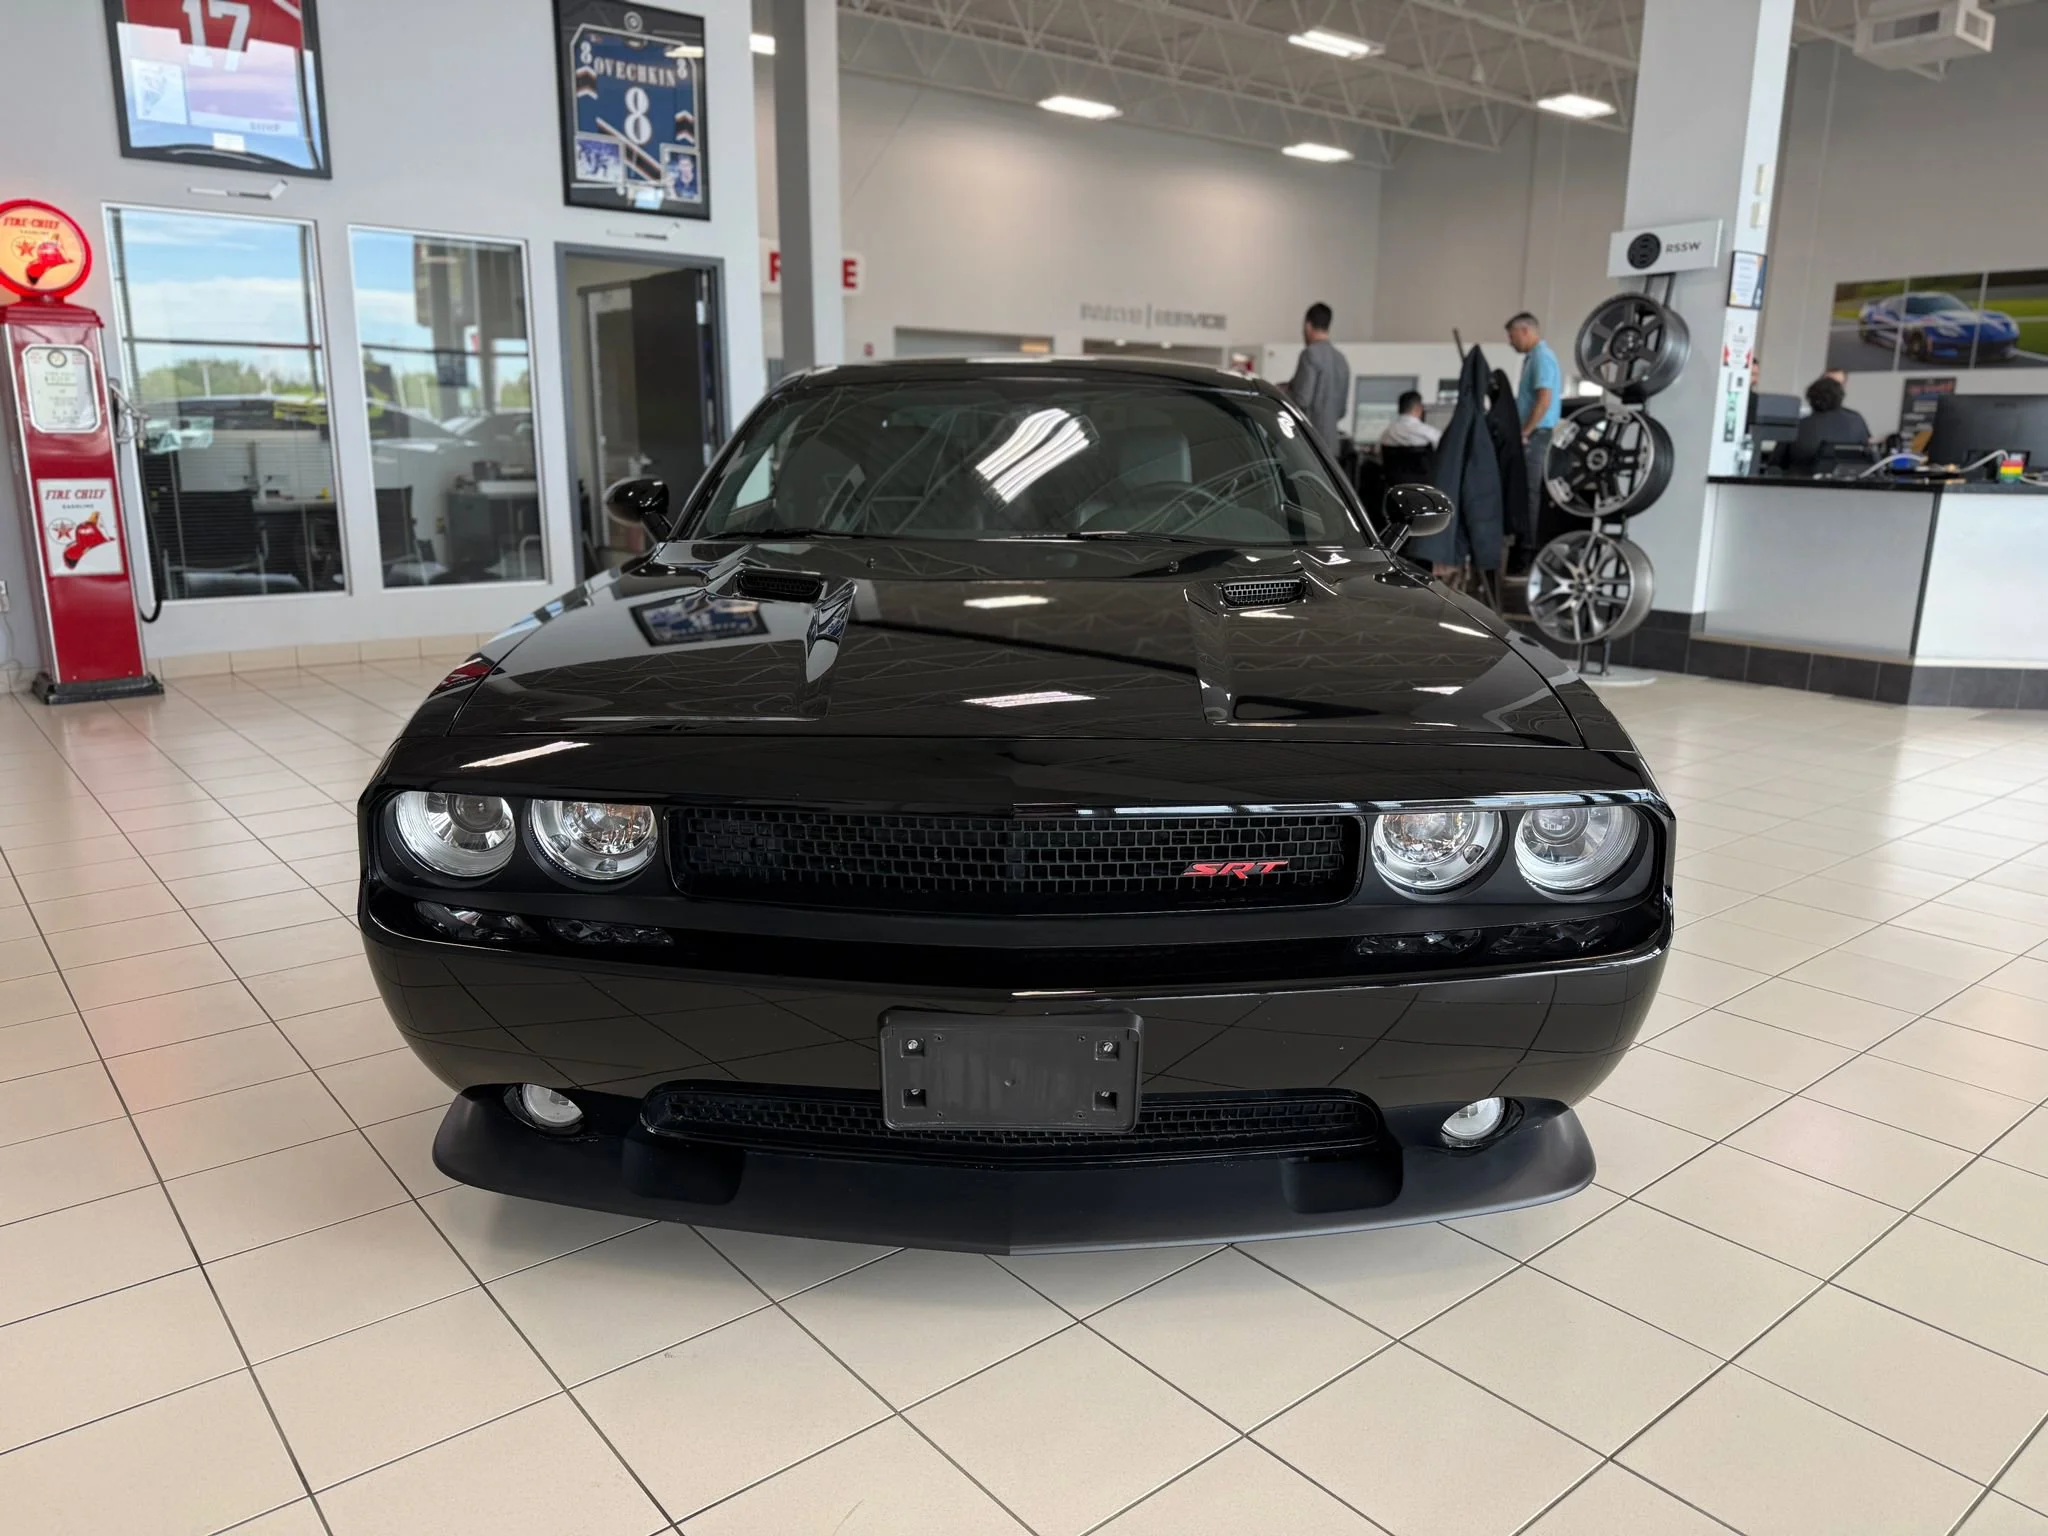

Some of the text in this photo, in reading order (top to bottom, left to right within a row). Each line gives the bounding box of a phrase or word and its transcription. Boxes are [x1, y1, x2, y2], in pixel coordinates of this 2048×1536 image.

[181, 0, 250, 72] 17
[593, 57, 676, 87] OVECHKIN
[624, 87, 652, 145] 8
[1665, 241, 1702, 253] RSSW
[45, 488, 107, 500] FIRE CHIEF
[1183, 861, 1289, 879] SRT
